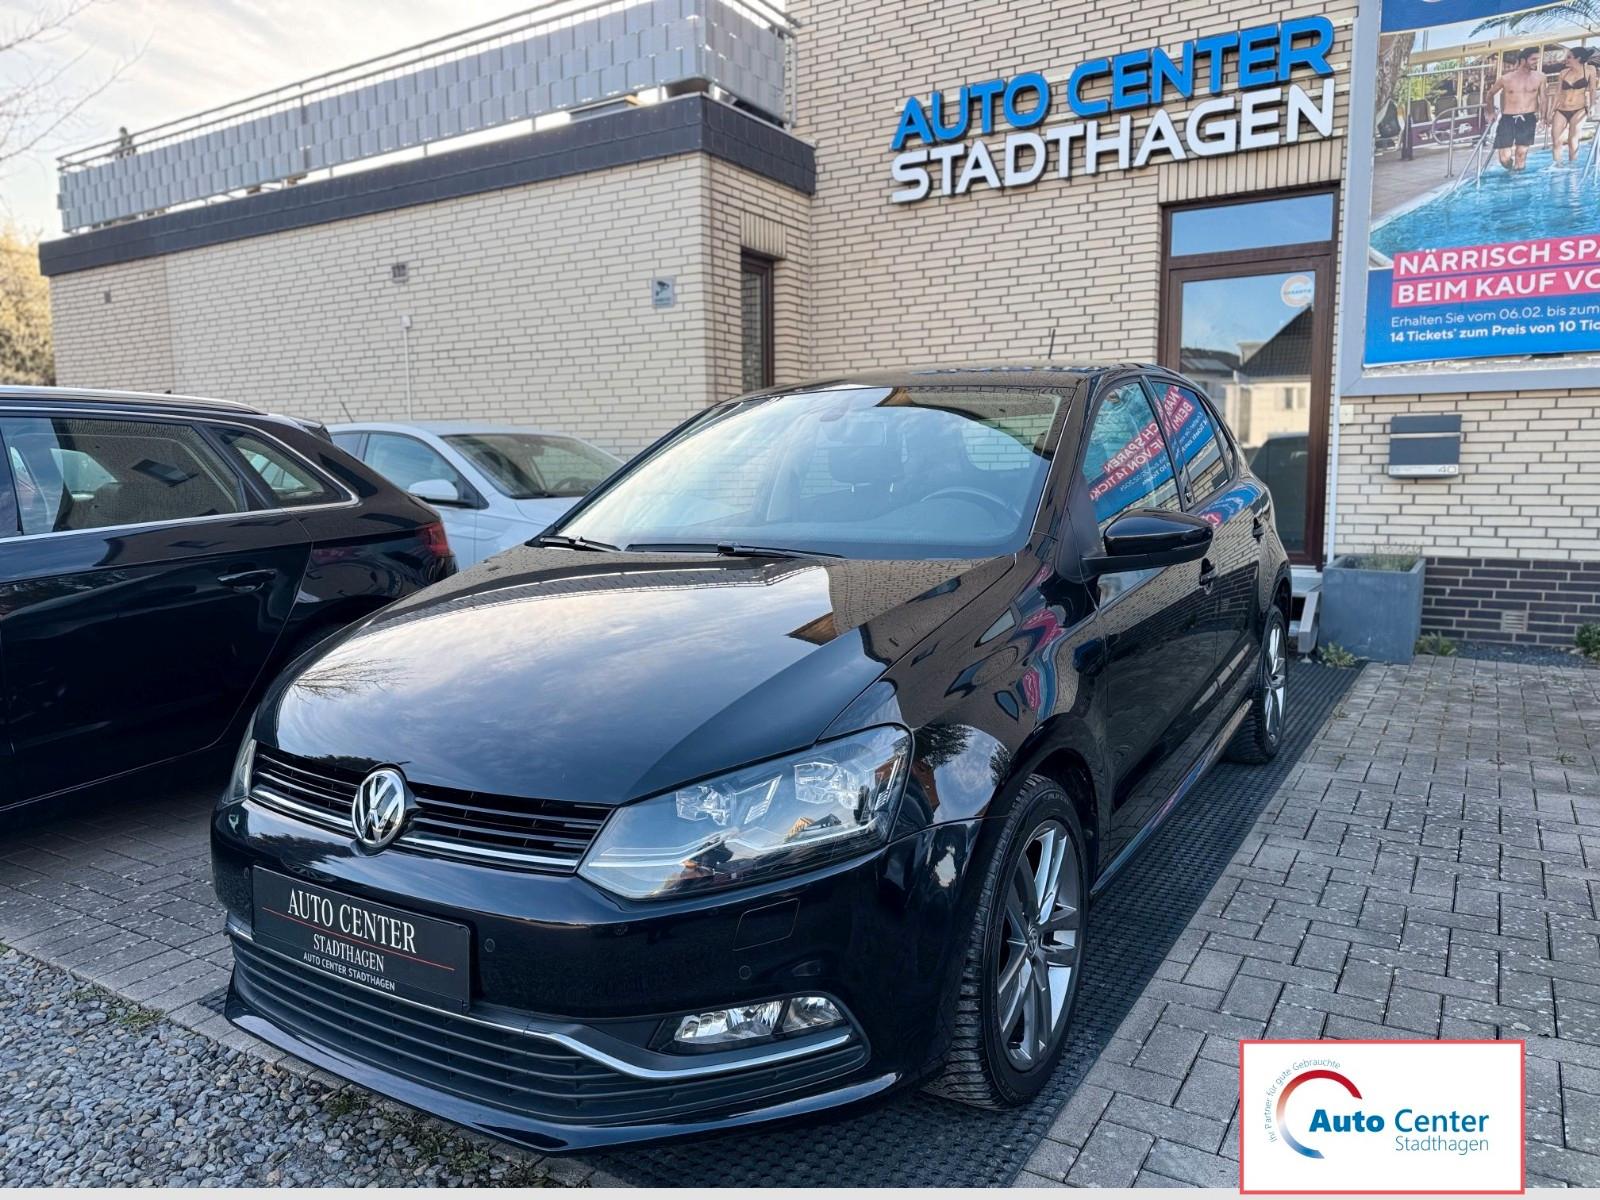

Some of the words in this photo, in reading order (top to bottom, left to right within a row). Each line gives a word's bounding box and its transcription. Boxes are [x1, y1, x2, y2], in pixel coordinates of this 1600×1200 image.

[890, 72, 1051, 150] AUTO
[1066, 15, 1335, 118] CENTER
[890, 78, 1336, 203] STADTHAGEN
[1399, 243, 1550, 276] NÄRRISCH
[1558, 238, 1600, 262] SP
[1397, 279, 1468, 304] BEIM
[1474, 272, 1557, 298] KAUF
[1389, 332, 1404, 343] 14
[1459, 328, 1489, 339] zum
[1491, 325, 1527, 337] Preis
[1529, 323, 1556, 334] von
[1559, 320, 1576, 332] 10
[1391, 314, 1443, 328] Erhalten
[1445, 313, 1465, 325] Sie
[1467, 312, 1496, 322] vom
[1499, 306, 1544, 320] 06.02.
[1547, 305, 1567, 317] bis
[1569, 304, 1600, 317] zum
[1438, 465, 1457, 473] 40
[288, 888, 335, 928] AUTO
[339, 904, 417, 954] CENTER
[303, 952, 321, 966] AUTO
[321, 959, 347, 975] CENTER
[348, 967, 396, 991] STADTHAGEN
[313, 933, 384, 973] STADTHAGEN
